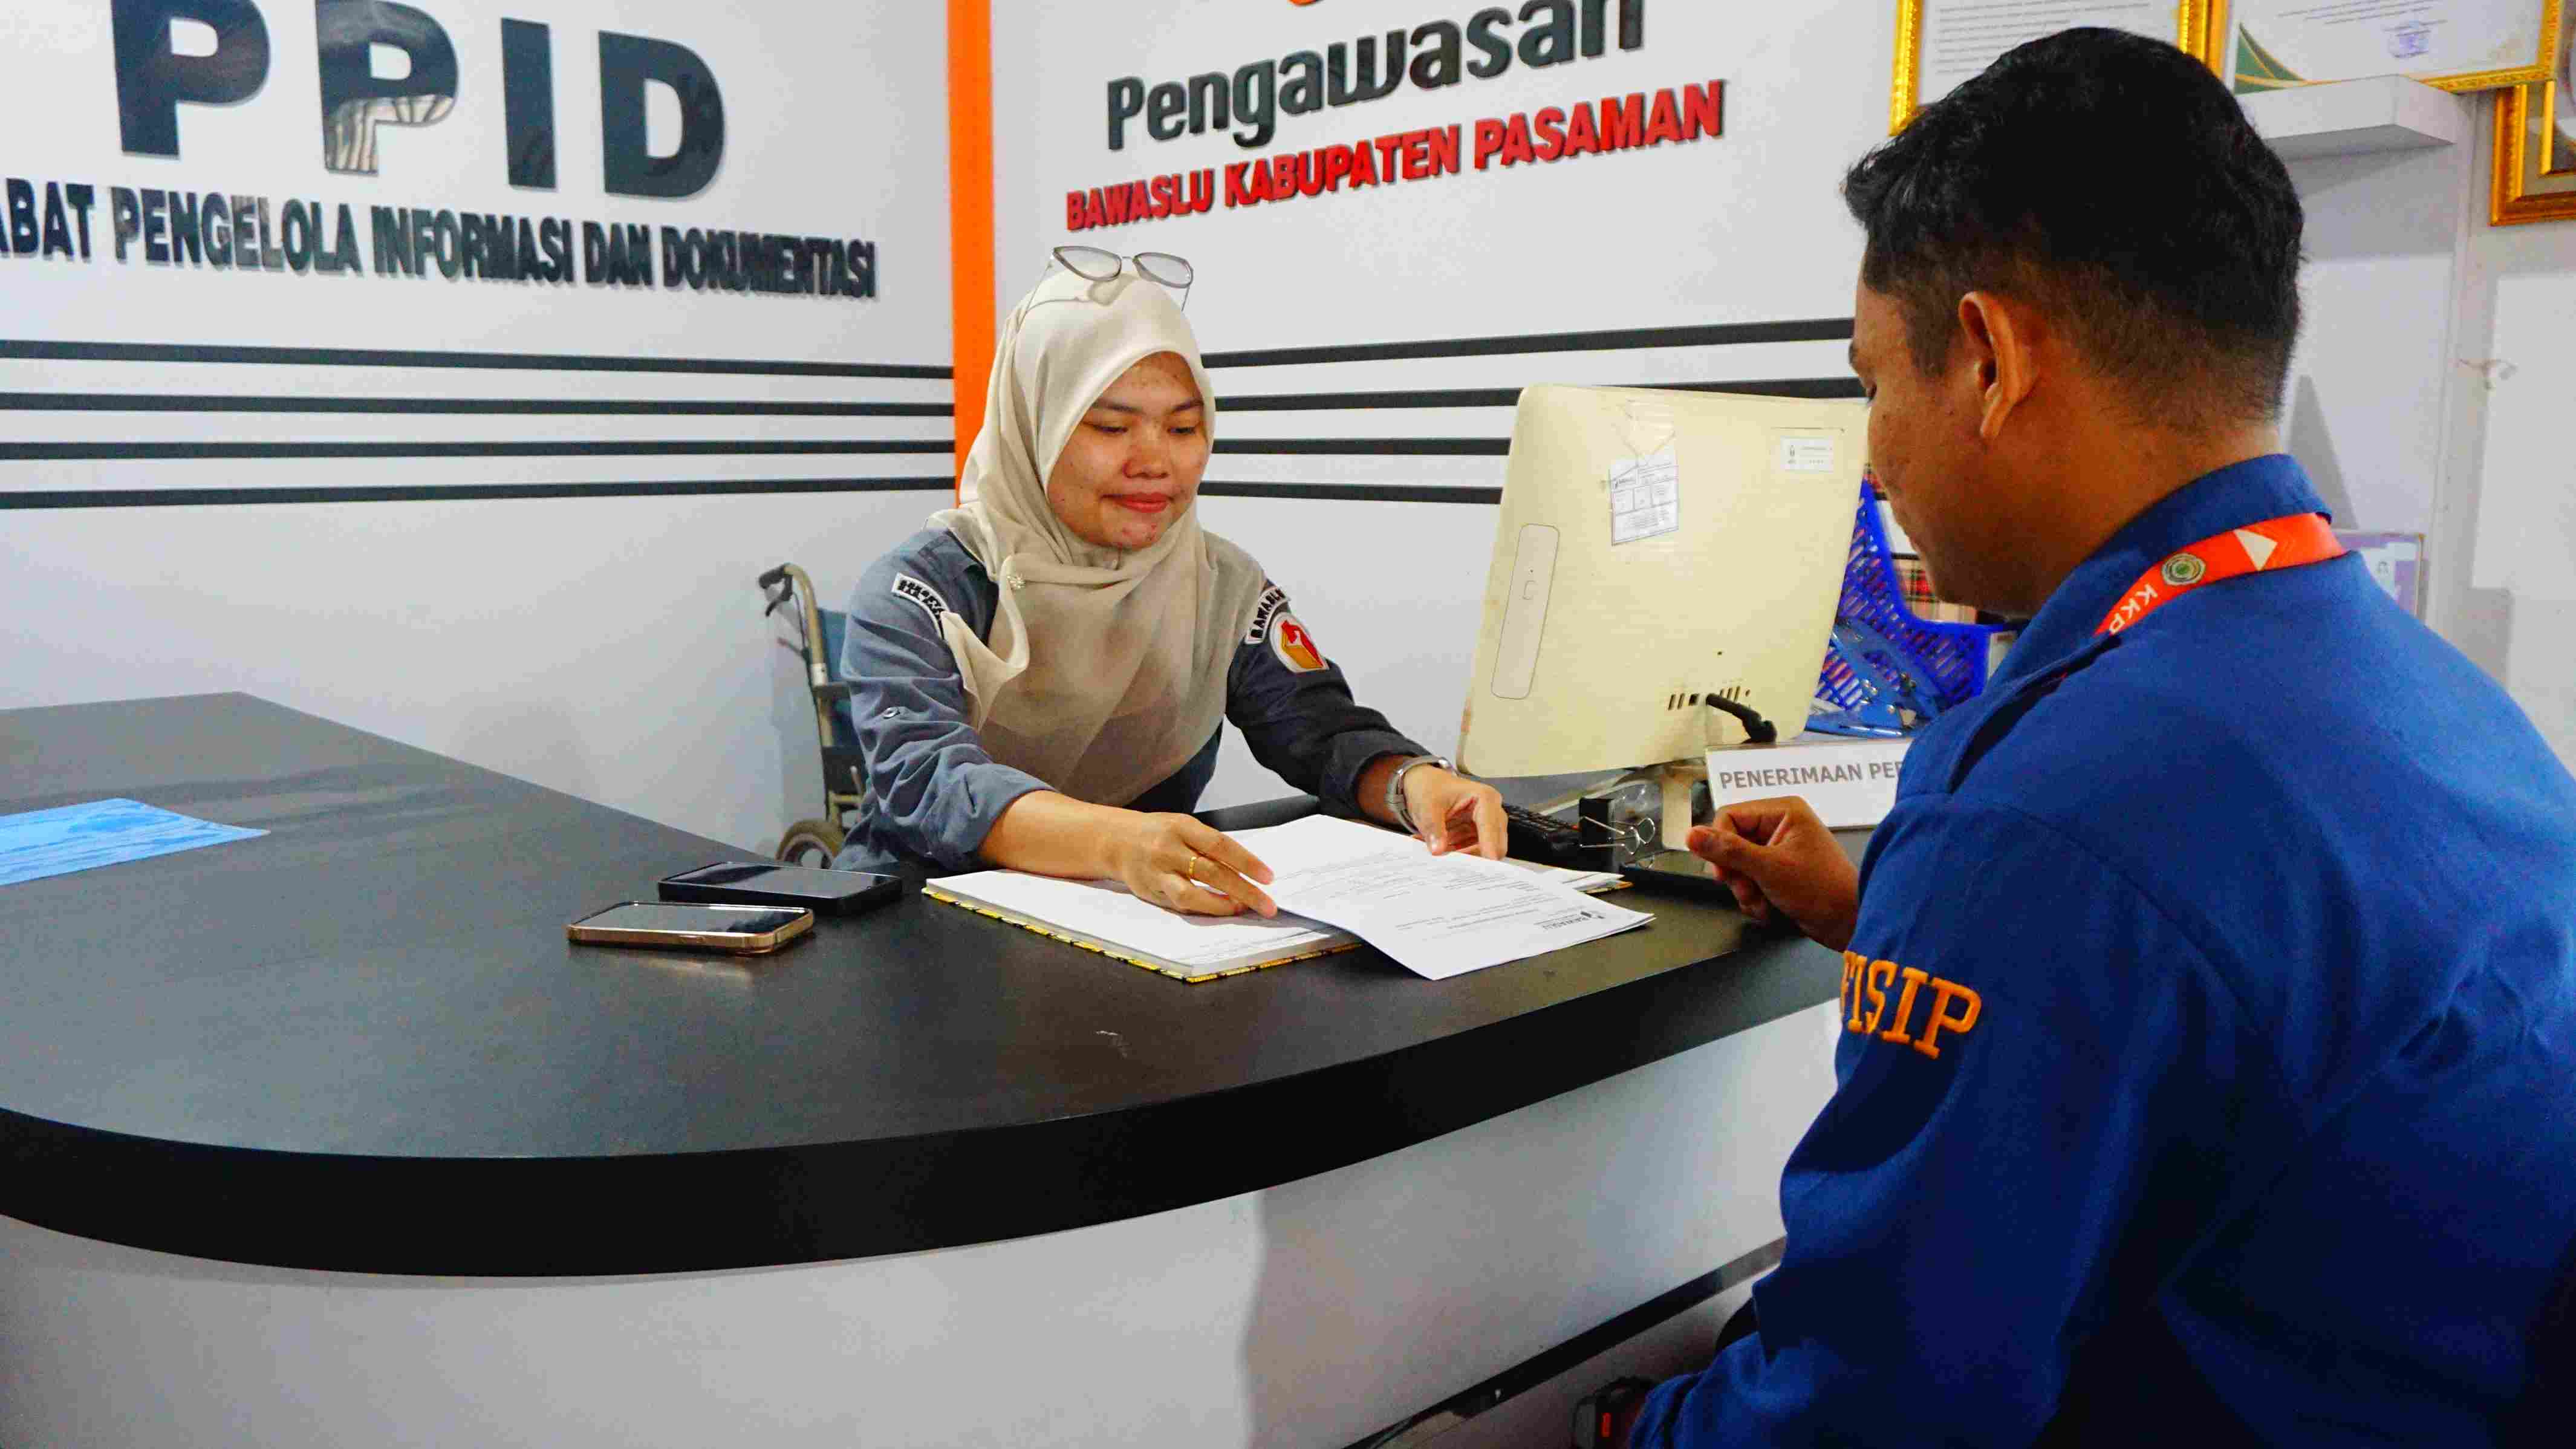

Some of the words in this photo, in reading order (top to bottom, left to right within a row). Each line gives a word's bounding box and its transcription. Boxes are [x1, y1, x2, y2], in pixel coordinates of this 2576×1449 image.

[111, 0, 725, 199] PPID
[1107, 0, 1644, 150] Pengawasan
[1066, 168, 1215, 232] BAWASLU
[1224, 125, 1461, 209] KABUPATEN
[1474, 79, 1725, 170] PASAMAN
[0, 177, 95, 259] BAT
[111, 186, 363, 278] PENGELOLA
[371, 205, 574, 284] INFORMASI
[583, 221, 652, 286] DAN
[661, 225, 876, 299] DOKUMENTASI
[2109, 583, 2158, 634] KKP
[1720, 763, 1862, 789] PENERIMAAN
